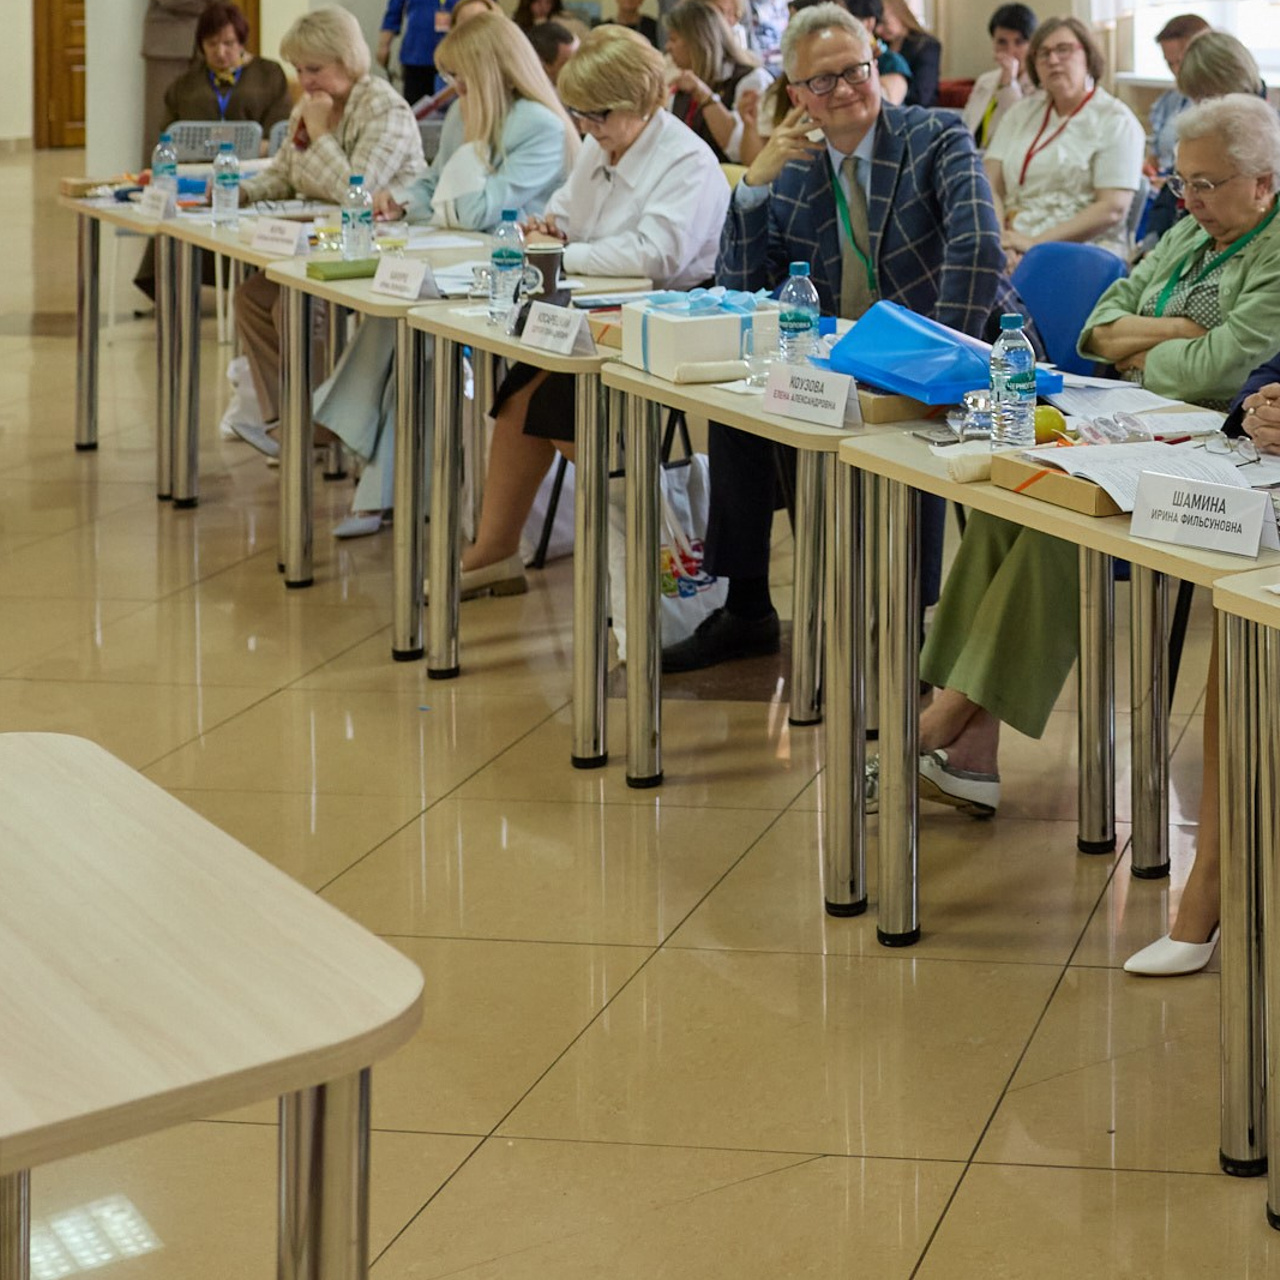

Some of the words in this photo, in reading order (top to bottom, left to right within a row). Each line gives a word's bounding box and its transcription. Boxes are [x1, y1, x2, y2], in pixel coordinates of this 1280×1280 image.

[789, 376, 825, 394] КОУЗОВА
[773, 389, 790, 401] ЕЛЕНА
[790, 393, 836, 410] АЛЕКСАНДРОВНА
[1172, 490, 1226, 514] ШАМИНА
[1151, 509, 1179, 524] ИРИНА
[1180, 514, 1243, 534] ФИЛЬСУНОВНА
